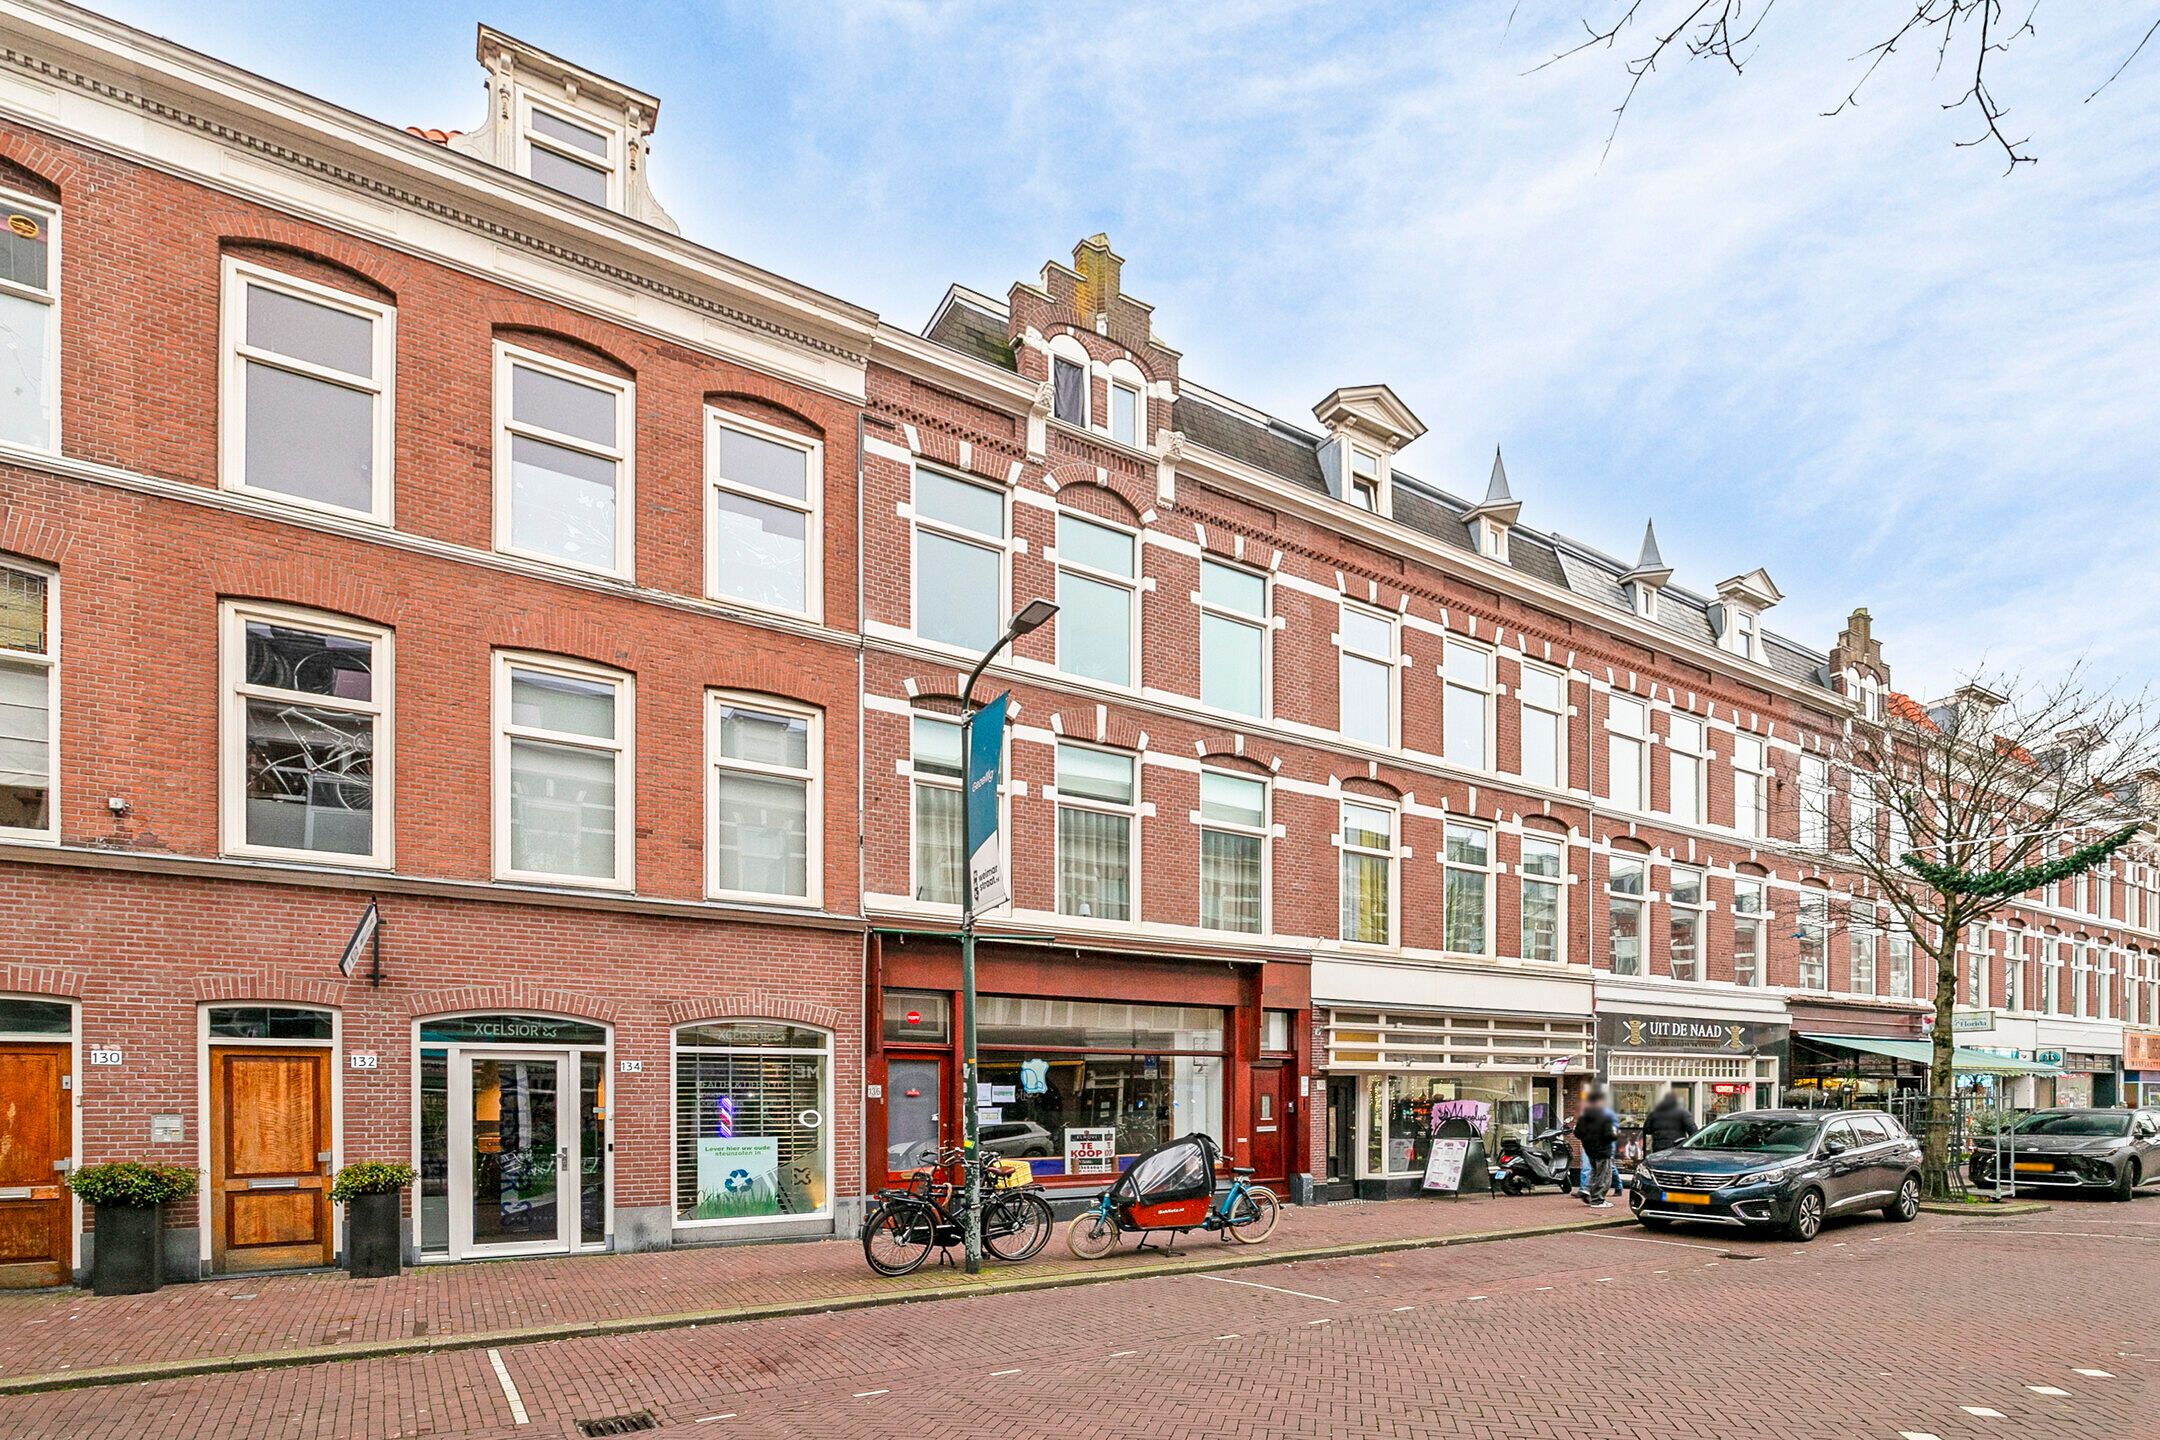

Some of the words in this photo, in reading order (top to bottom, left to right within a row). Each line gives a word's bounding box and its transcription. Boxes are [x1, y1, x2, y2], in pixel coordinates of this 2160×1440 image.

[474, 1023, 539, 1037] XCELSIOR
[1649, 1022, 1670, 1036] UIT
[1672, 1023, 1688, 1037] DE
[1690, 1024, 1722, 1038] NAAD
[93, 1052, 120, 1064] 130
[353, 1056, 375, 1067] 132
[622, 1062, 640, 1071] 134
